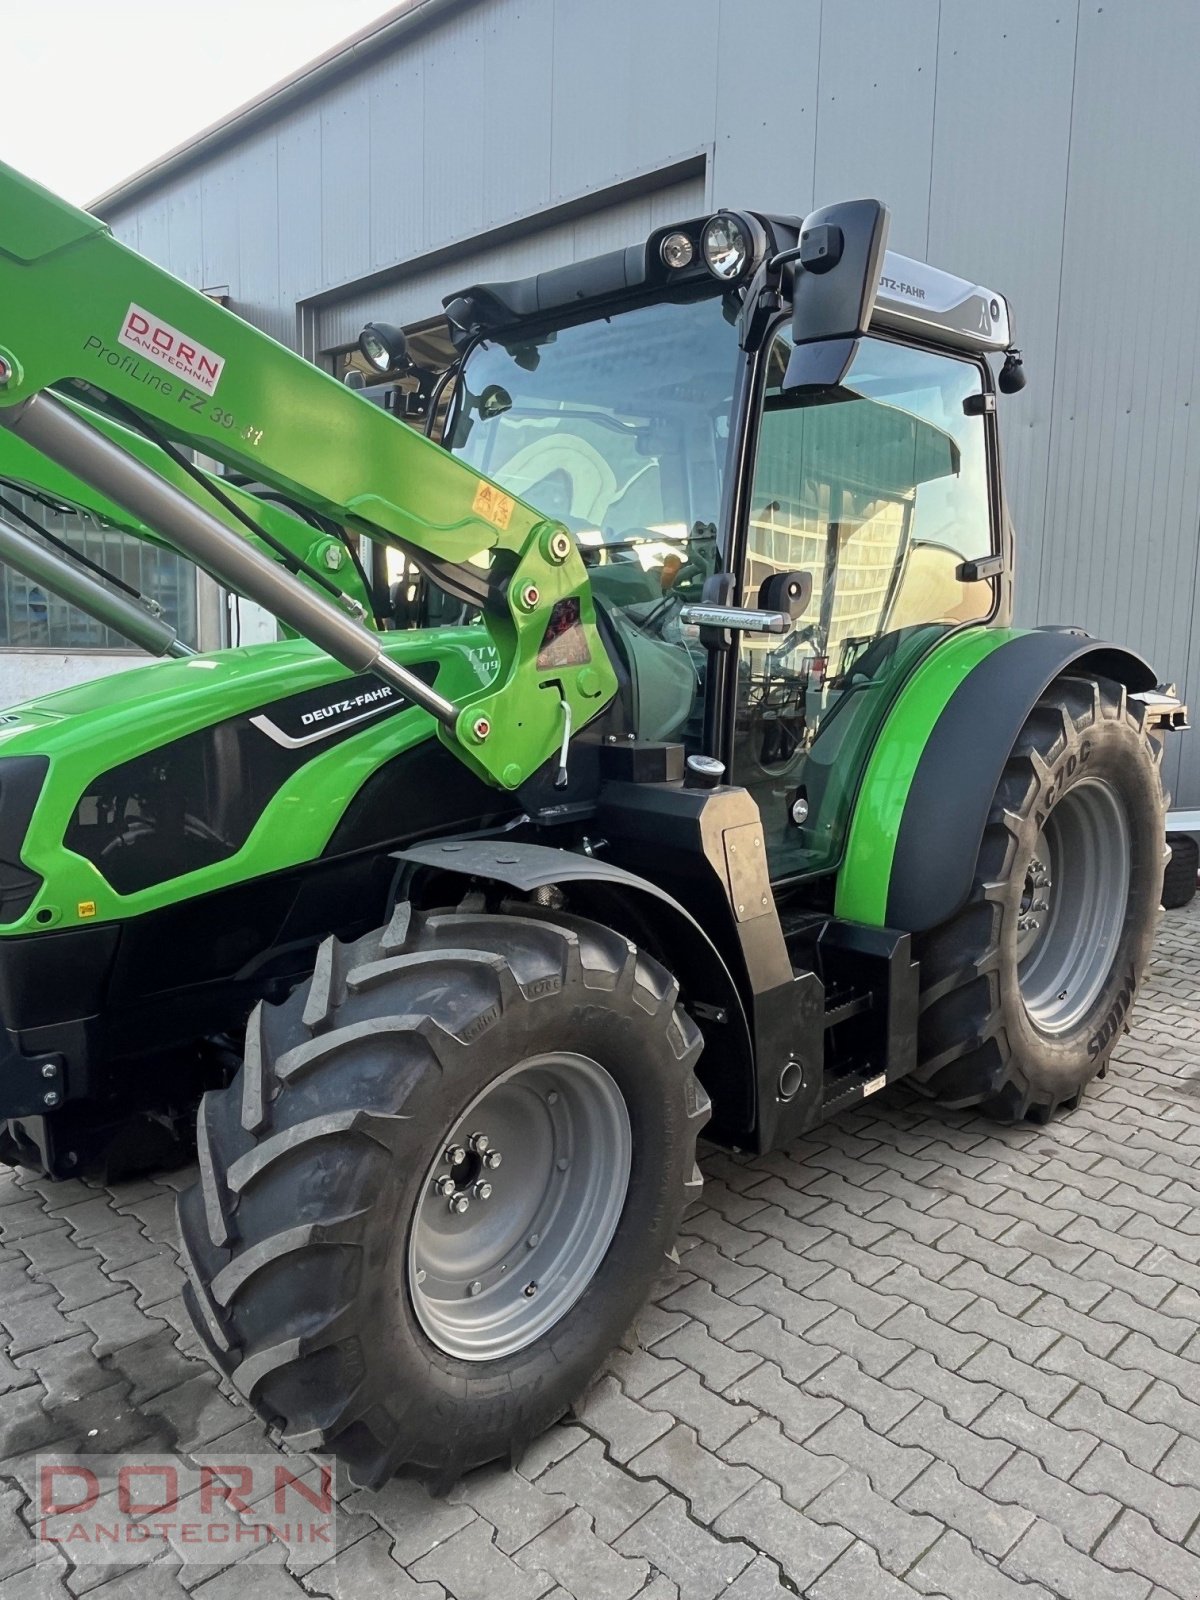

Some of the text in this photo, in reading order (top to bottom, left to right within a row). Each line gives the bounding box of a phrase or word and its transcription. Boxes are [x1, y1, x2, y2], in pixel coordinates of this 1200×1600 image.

[879, 276, 926, 300] UTZ-FAHR
[124, 328, 213, 388] LANDTECHNIK
[127, 312, 219, 379] DORN
[83, 335, 173, 396] ProfiLine
[177, 388, 208, 415] FZ
[468, 646, 497, 662] TTV
[300, 685, 393, 726] DEUTZ-FAHR
